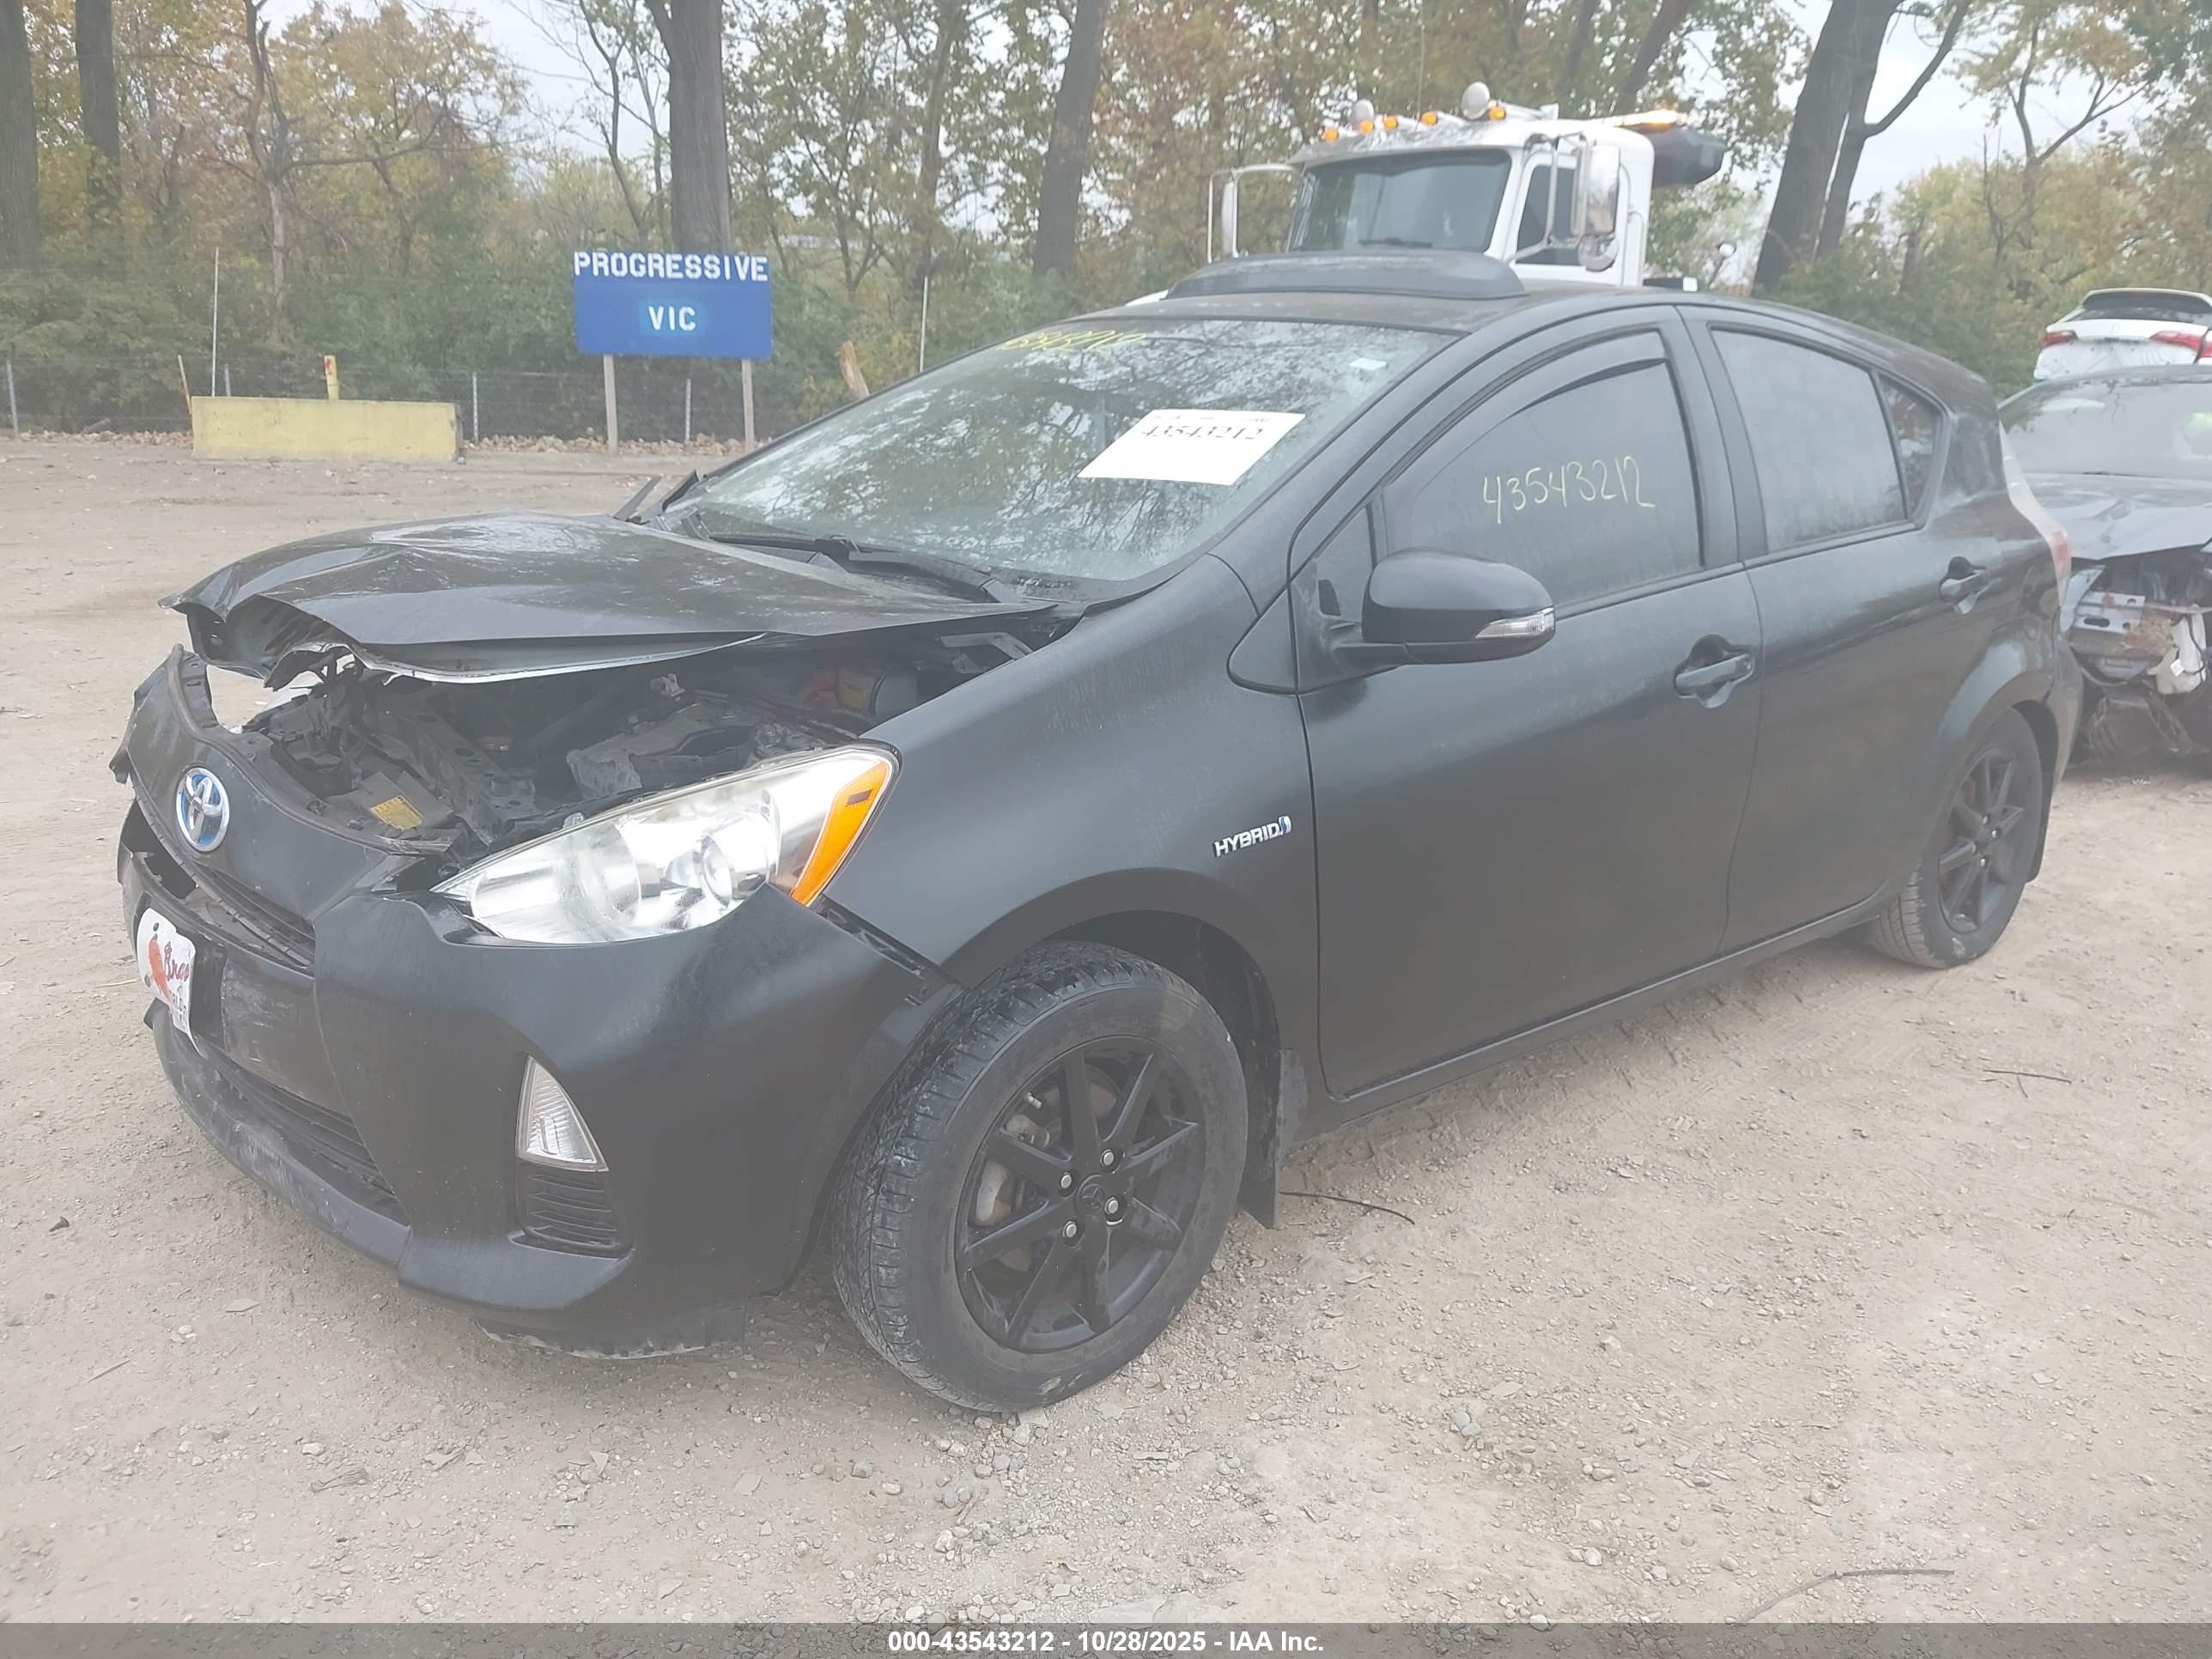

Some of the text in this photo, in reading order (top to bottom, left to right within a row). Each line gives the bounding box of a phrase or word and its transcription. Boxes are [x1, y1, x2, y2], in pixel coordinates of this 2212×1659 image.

[574, 251, 768, 282] PROGRESSIVE
[648, 306, 696, 331] VIC
[1483, 455, 1656, 524] 43543212
[1212, 822, 1283, 857] HYBRID
